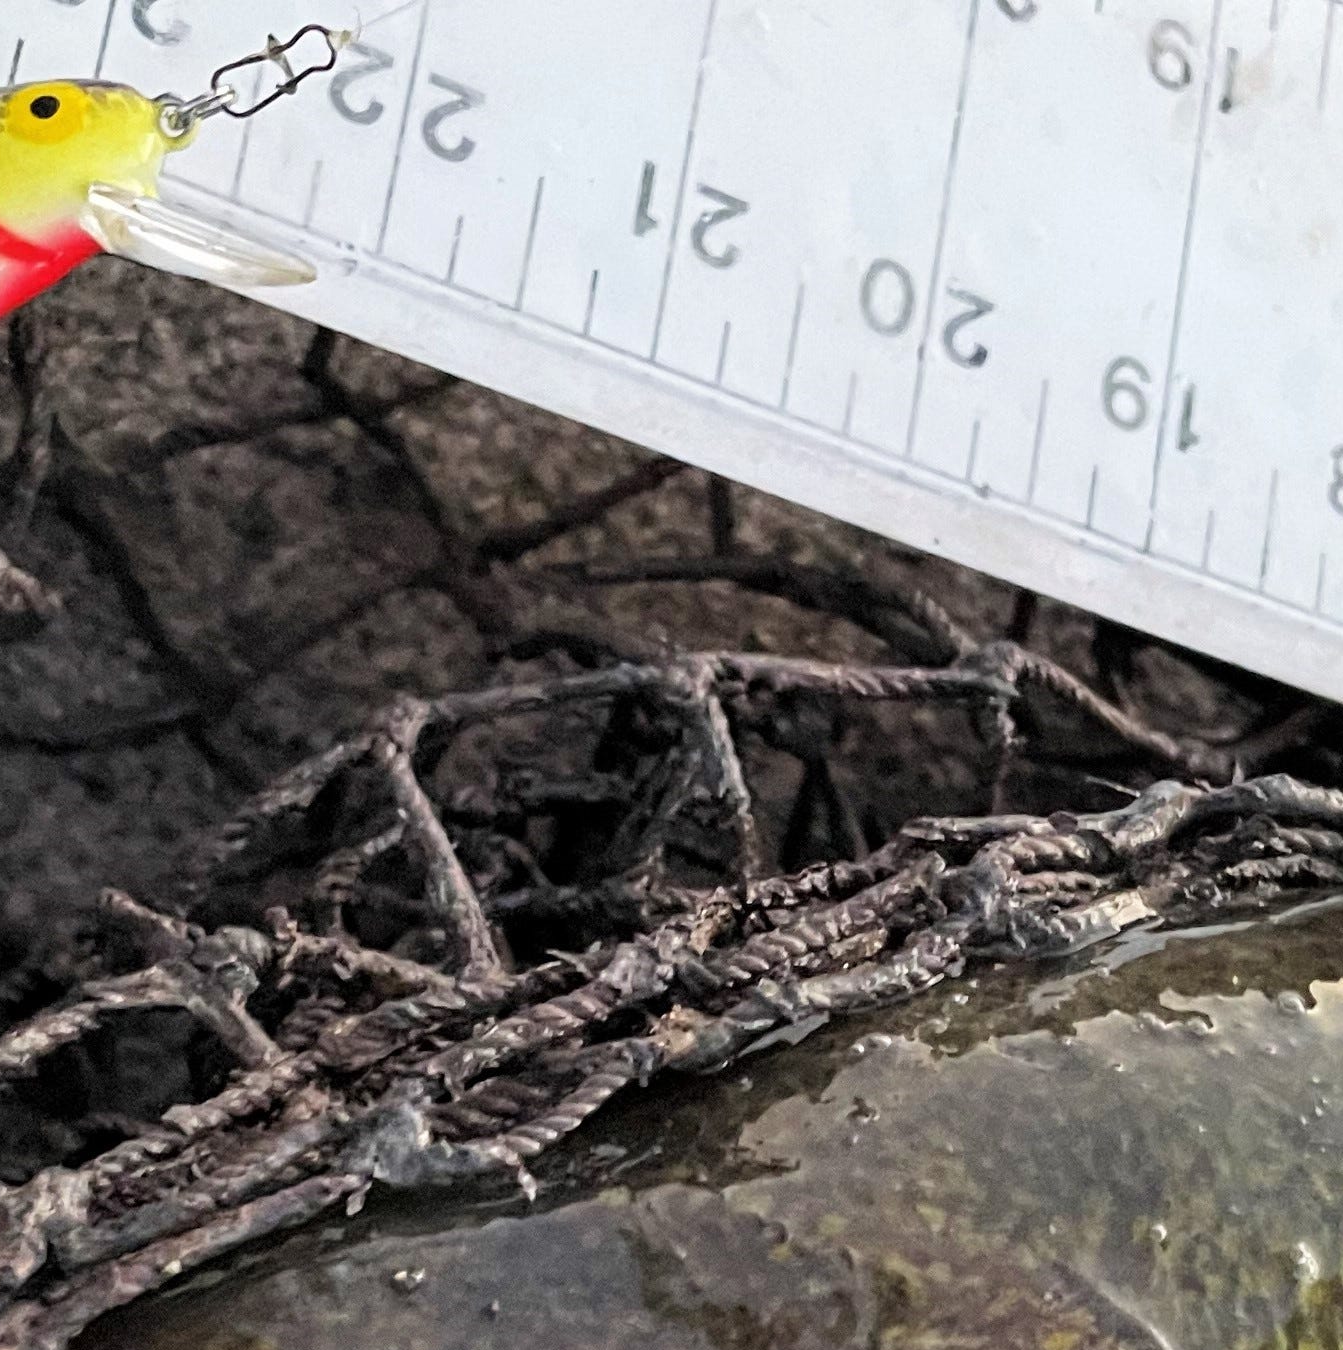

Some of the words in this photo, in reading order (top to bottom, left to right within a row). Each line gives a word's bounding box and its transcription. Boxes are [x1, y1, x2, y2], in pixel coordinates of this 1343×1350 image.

[329, 40, 486, 162] 22
[1147, 20, 1239, 113] 19
[632, 160, 751, 269] 21
[860, 257, 995, 368] 20
[1100, 356, 1200, 452] 19
